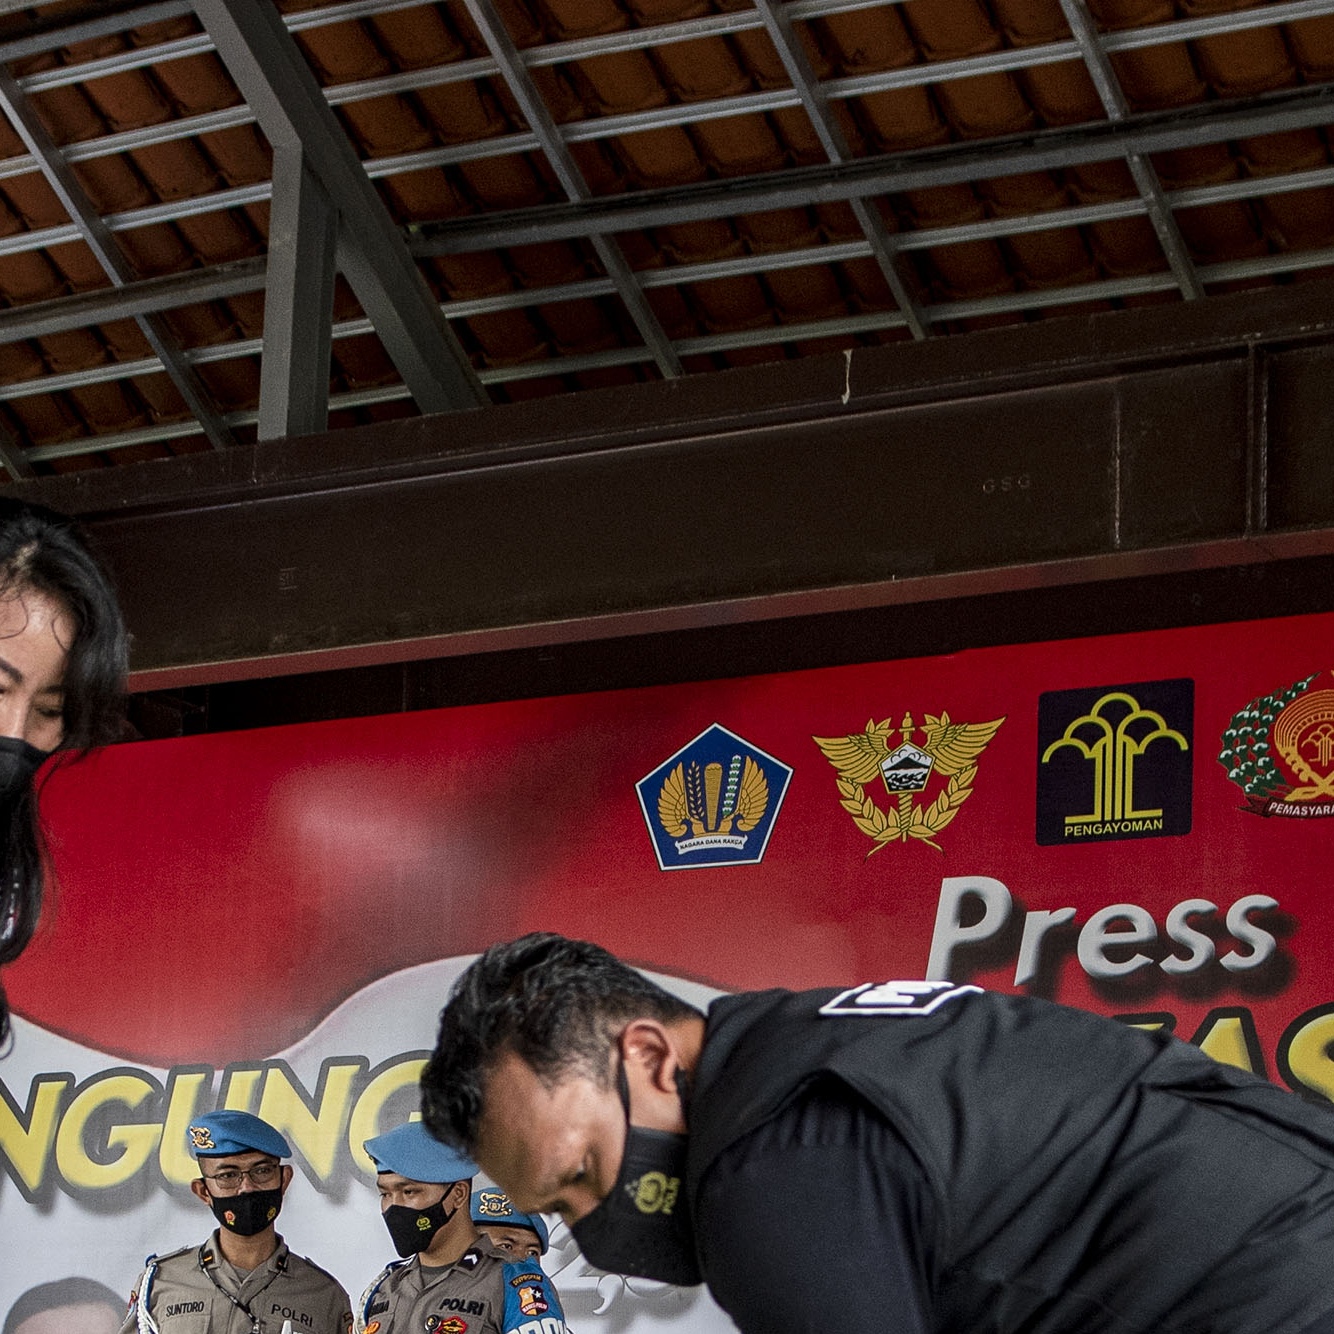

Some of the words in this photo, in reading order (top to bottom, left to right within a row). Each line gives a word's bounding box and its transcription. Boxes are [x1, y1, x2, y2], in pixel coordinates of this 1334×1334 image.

[1064, 818, 1164, 838] PENGAYOMAN
[925, 876, 1280, 986] Press
[166, 1301, 204, 1317] SUNTORO
[271, 1304, 313, 1327] POLRI
[439, 1298, 484, 1316] POLRI
